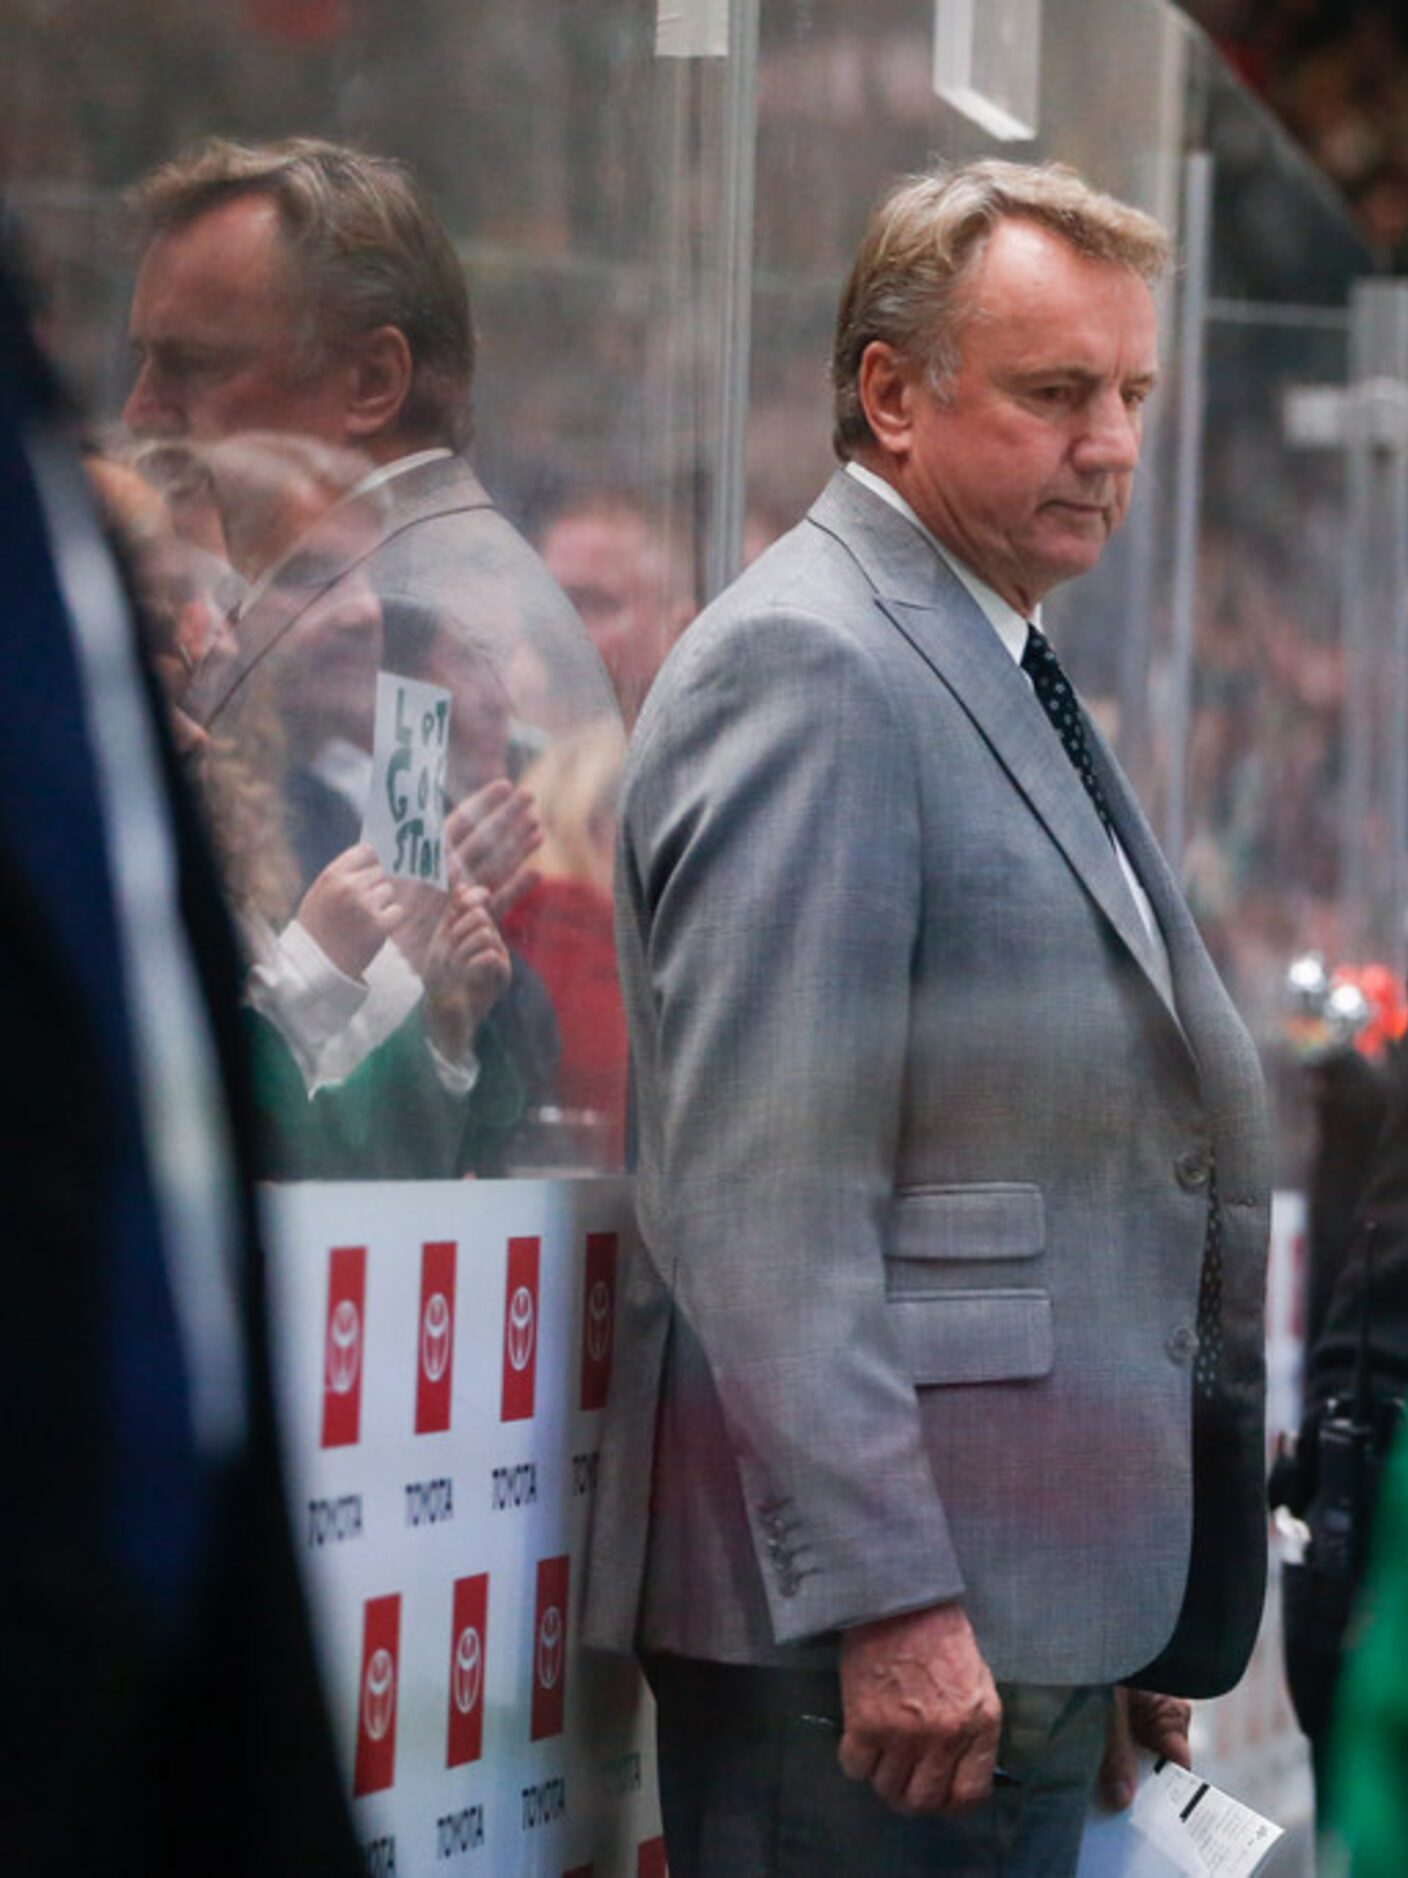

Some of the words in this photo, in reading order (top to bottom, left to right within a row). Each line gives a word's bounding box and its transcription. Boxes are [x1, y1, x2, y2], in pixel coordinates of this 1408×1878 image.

[403, 1478, 454, 1527] TOYOTA
[491, 1461, 538, 1511] TOYOTA
[307, 1493, 363, 1549] TOYOTA
[436, 1803, 486, 1860] TOYOTA
[521, 1777, 568, 1832] TOYOTA
